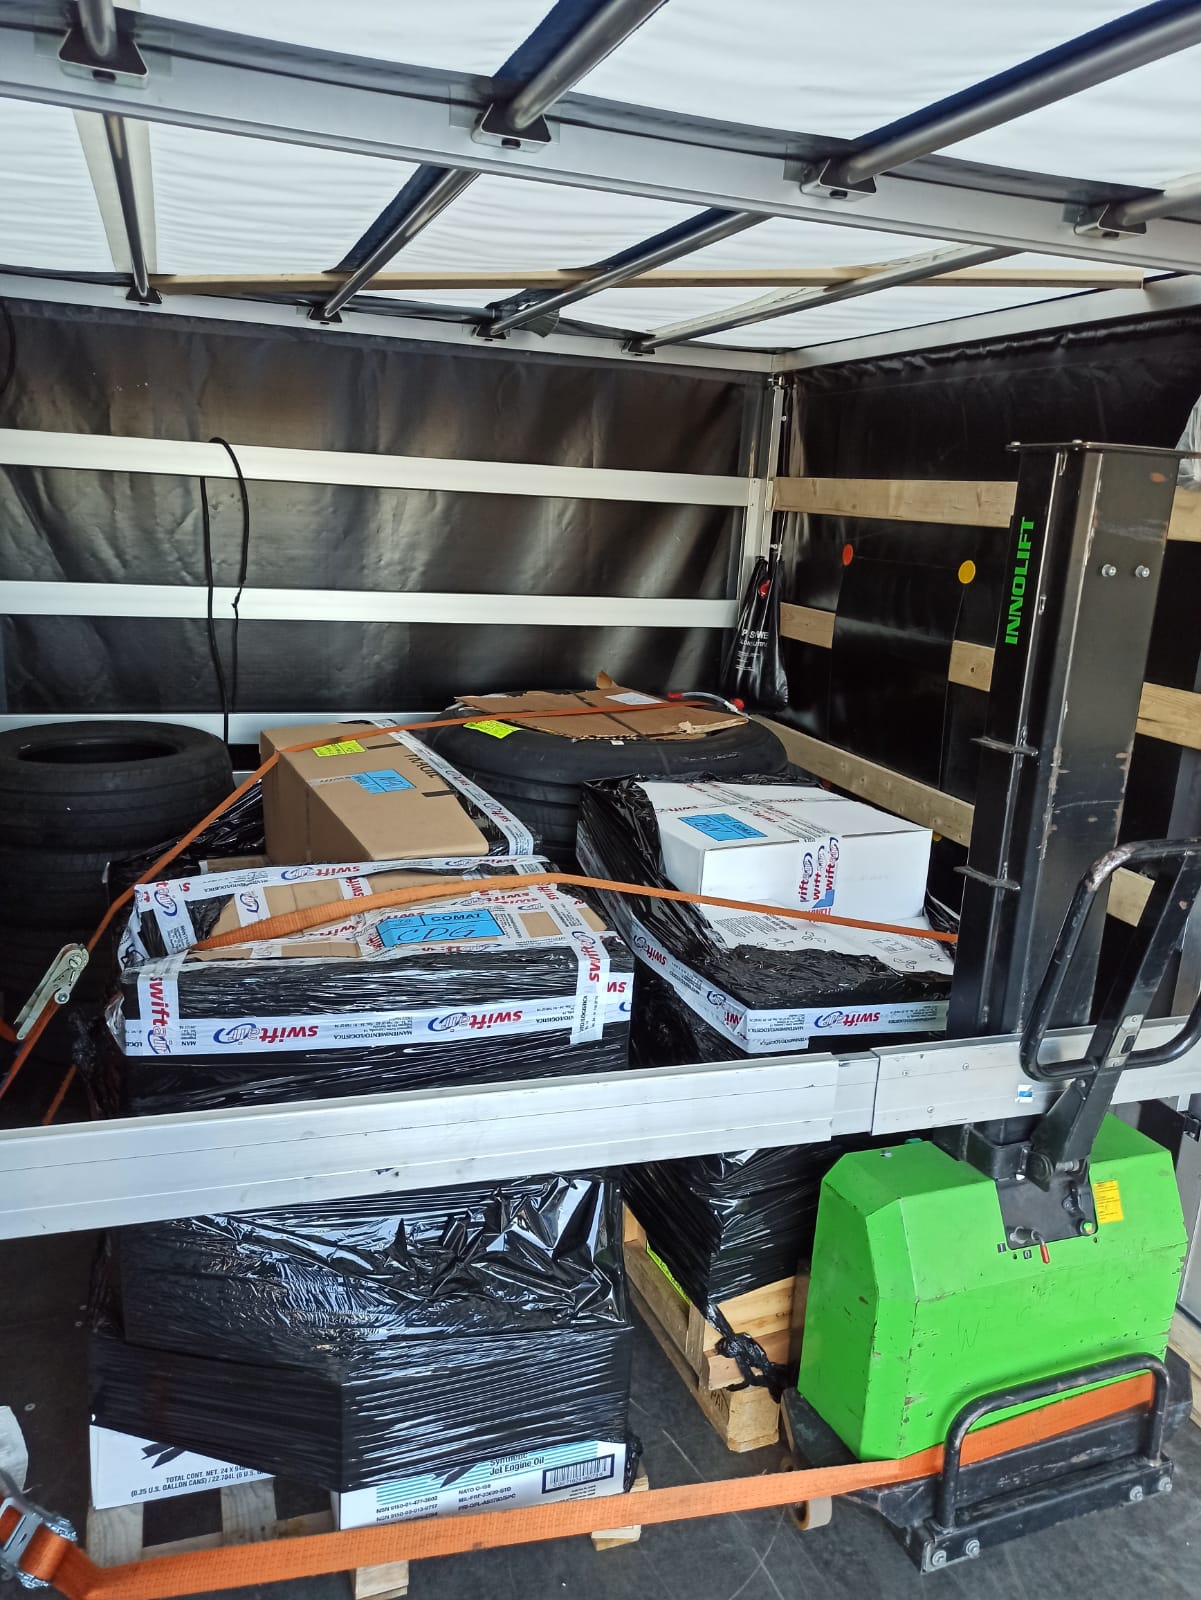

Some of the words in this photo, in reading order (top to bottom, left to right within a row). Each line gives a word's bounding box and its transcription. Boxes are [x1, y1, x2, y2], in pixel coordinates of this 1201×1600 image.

[1004, 516, 1034, 645] INNOLIFT
[434, 1010, 523, 1030] swiftair
[221, 1023, 319, 1044] swiftair
[489, 1466, 503, 1476] Jet
[504, 1461, 532, 1473] Engine
[534, 1456, 545, 1466] Oil
[162, 1480, 188, 1491] GALLON
[188, 1477, 207, 1486] CANS)
[165, 1475, 185, 1484] TOTAL
[458, 1487, 474, 1495] NATO
